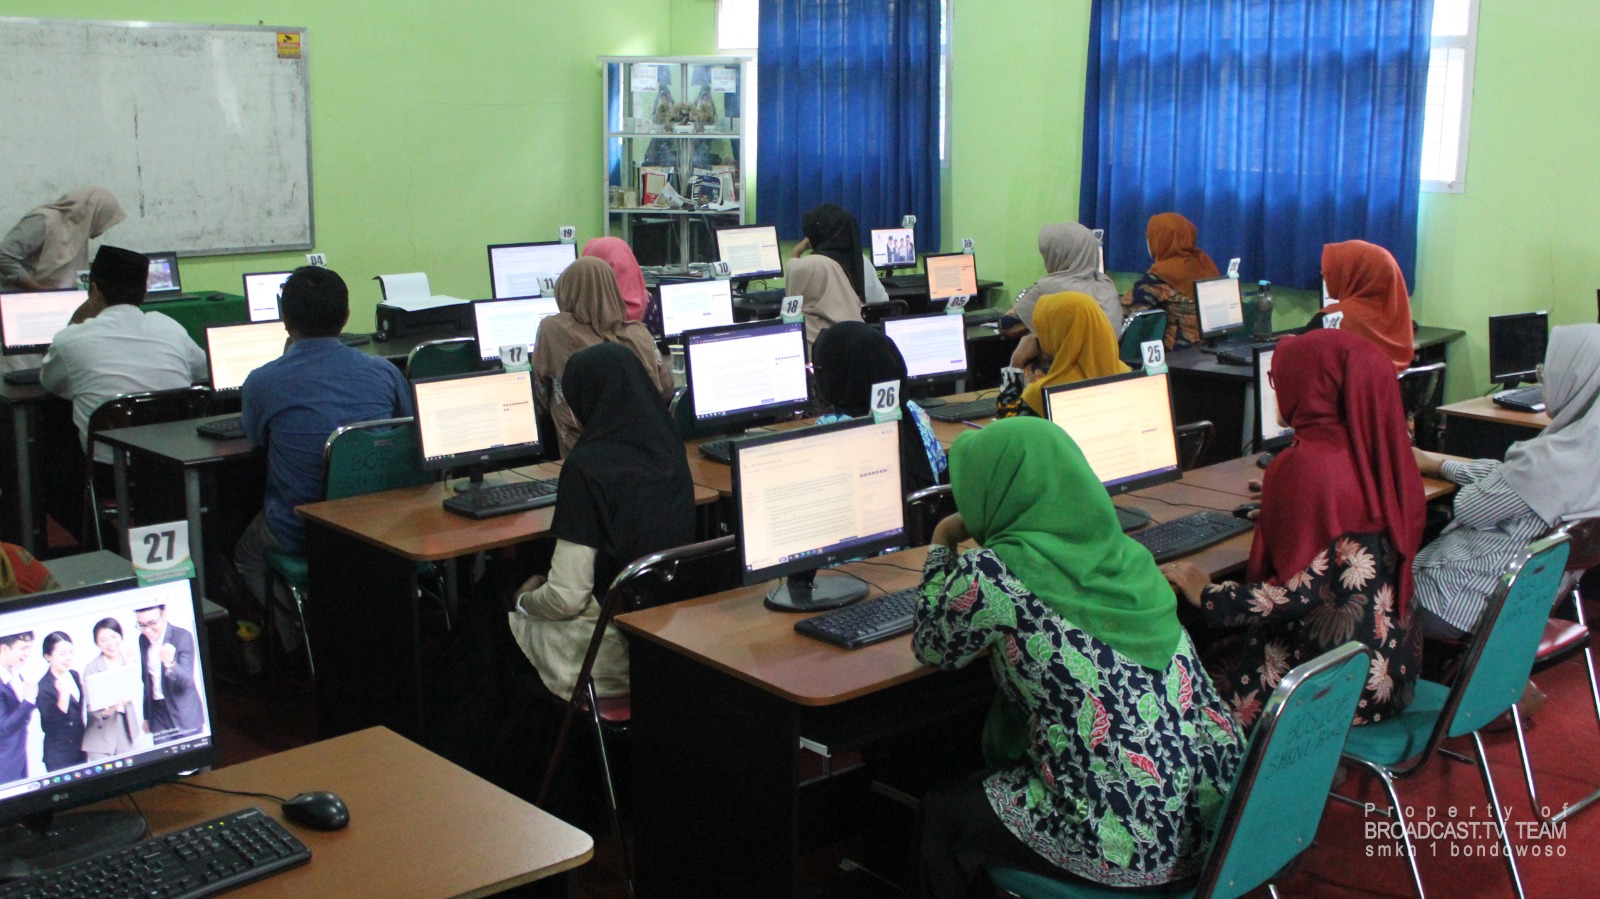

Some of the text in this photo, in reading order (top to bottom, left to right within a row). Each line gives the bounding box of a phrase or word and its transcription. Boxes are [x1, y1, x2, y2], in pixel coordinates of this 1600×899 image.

[563, 228, 573, 239] 19
[310, 255, 323, 266] 04
[718, 262, 729, 273] 10
[544, 277, 554, 290] 11
[786, 299, 799, 314] 18
[950, 296, 966, 308] 05
[508, 346, 523, 363] 17
[1147, 344, 1162, 364] 25
[876, 386, 895, 409] 26
[143, 530, 176, 565] 27
